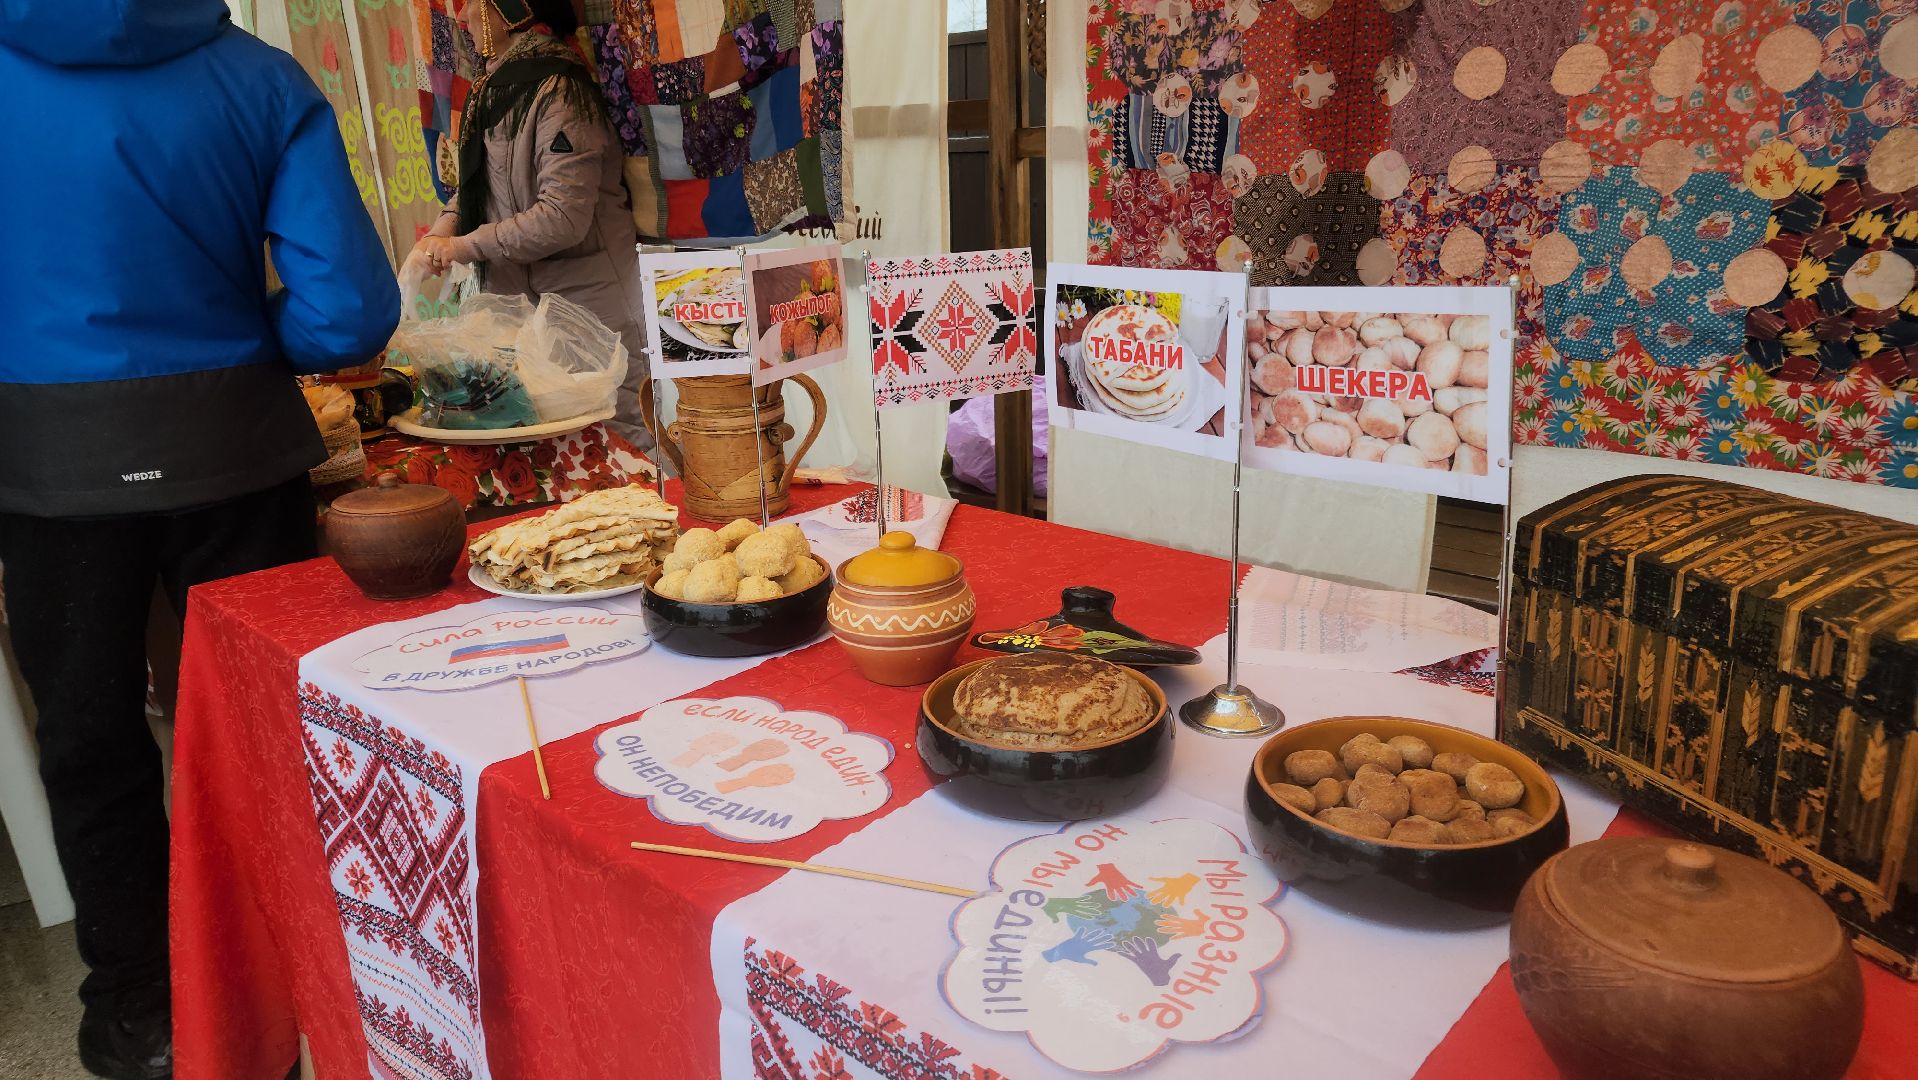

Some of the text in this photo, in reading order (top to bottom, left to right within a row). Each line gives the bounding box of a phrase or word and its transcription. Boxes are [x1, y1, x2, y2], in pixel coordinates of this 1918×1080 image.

[1090, 335, 1184, 371] ТАБАНИ
[1296, 364, 1433, 402] ШЕКЕРА
[121, 470, 163, 483] WEDZE
[381, 638, 636, 683] В ДРУЖБЕ НАРОДОВ!
[616, 735, 794, 831] ОН НЕПОБЕДИМ
